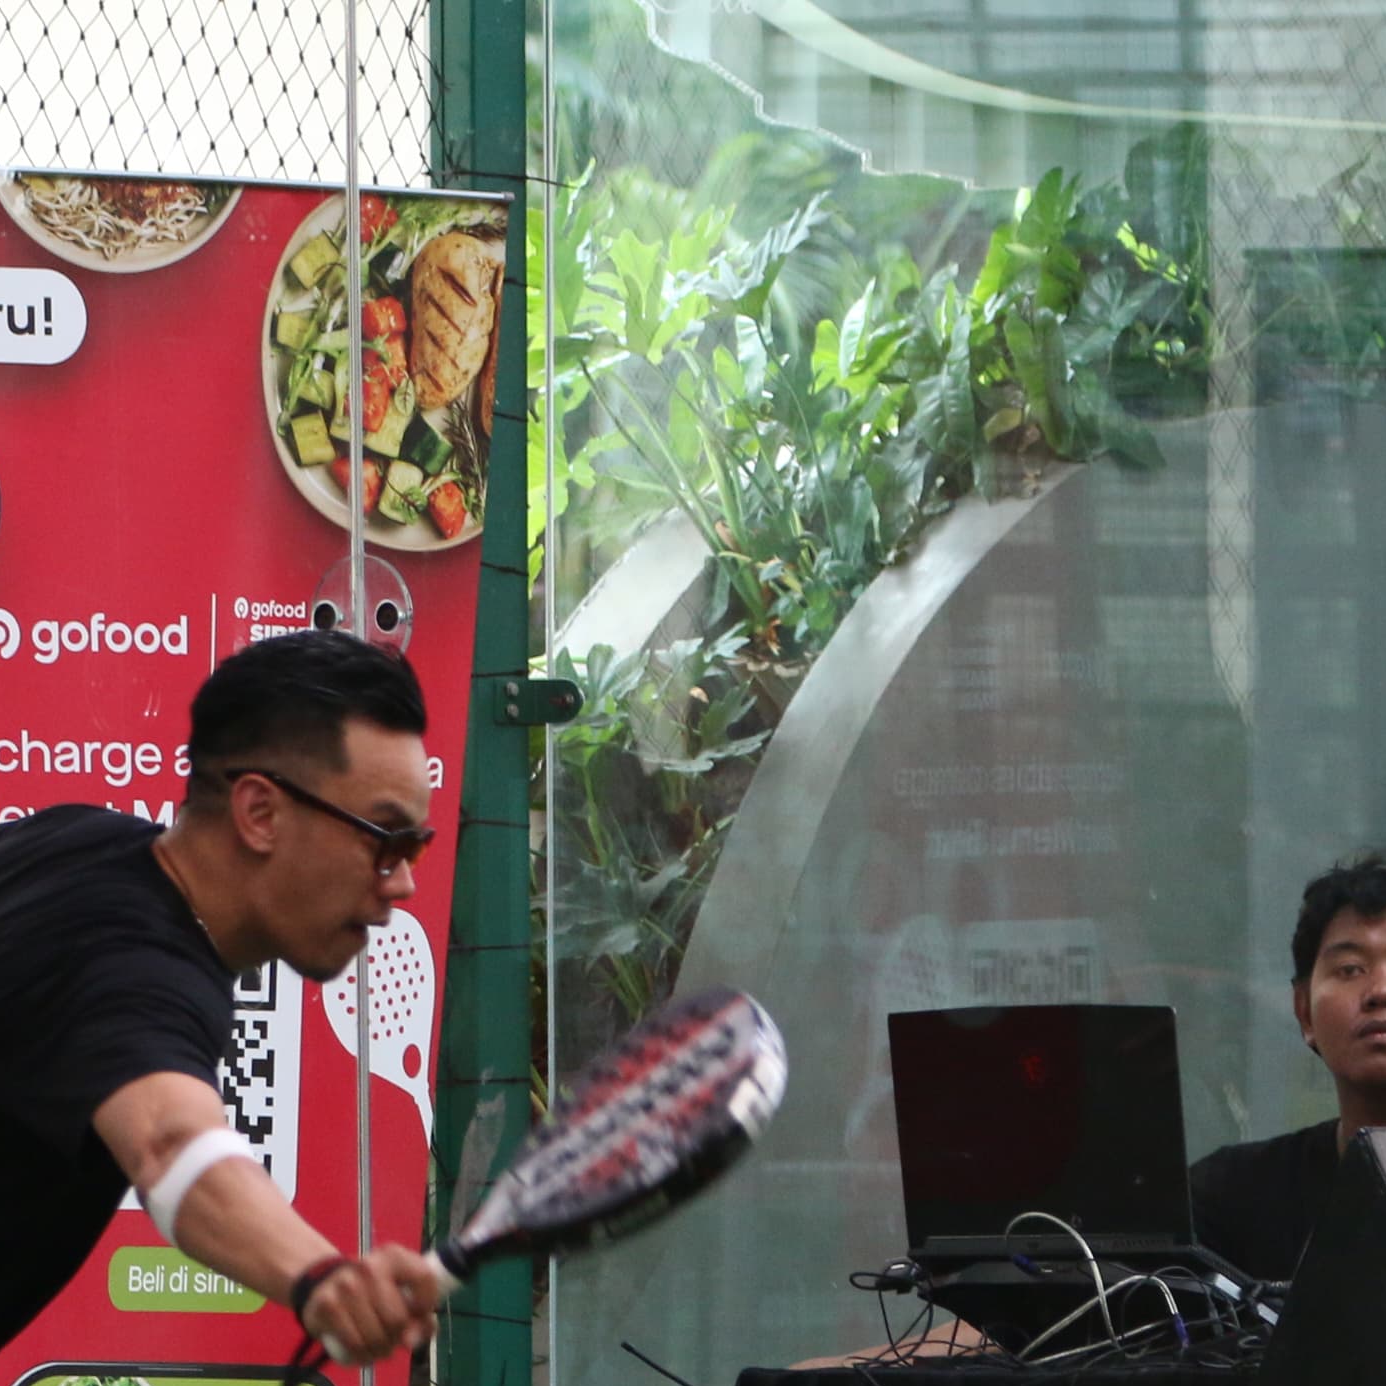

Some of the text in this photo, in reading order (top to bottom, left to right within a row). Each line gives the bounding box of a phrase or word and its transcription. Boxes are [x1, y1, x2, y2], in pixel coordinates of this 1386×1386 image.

[251, 600, 306, 621] gofood
[31, 612, 188, 664] gofood
[129, 1265, 165, 1292] Beli
[169, 1265, 189, 1293] di
